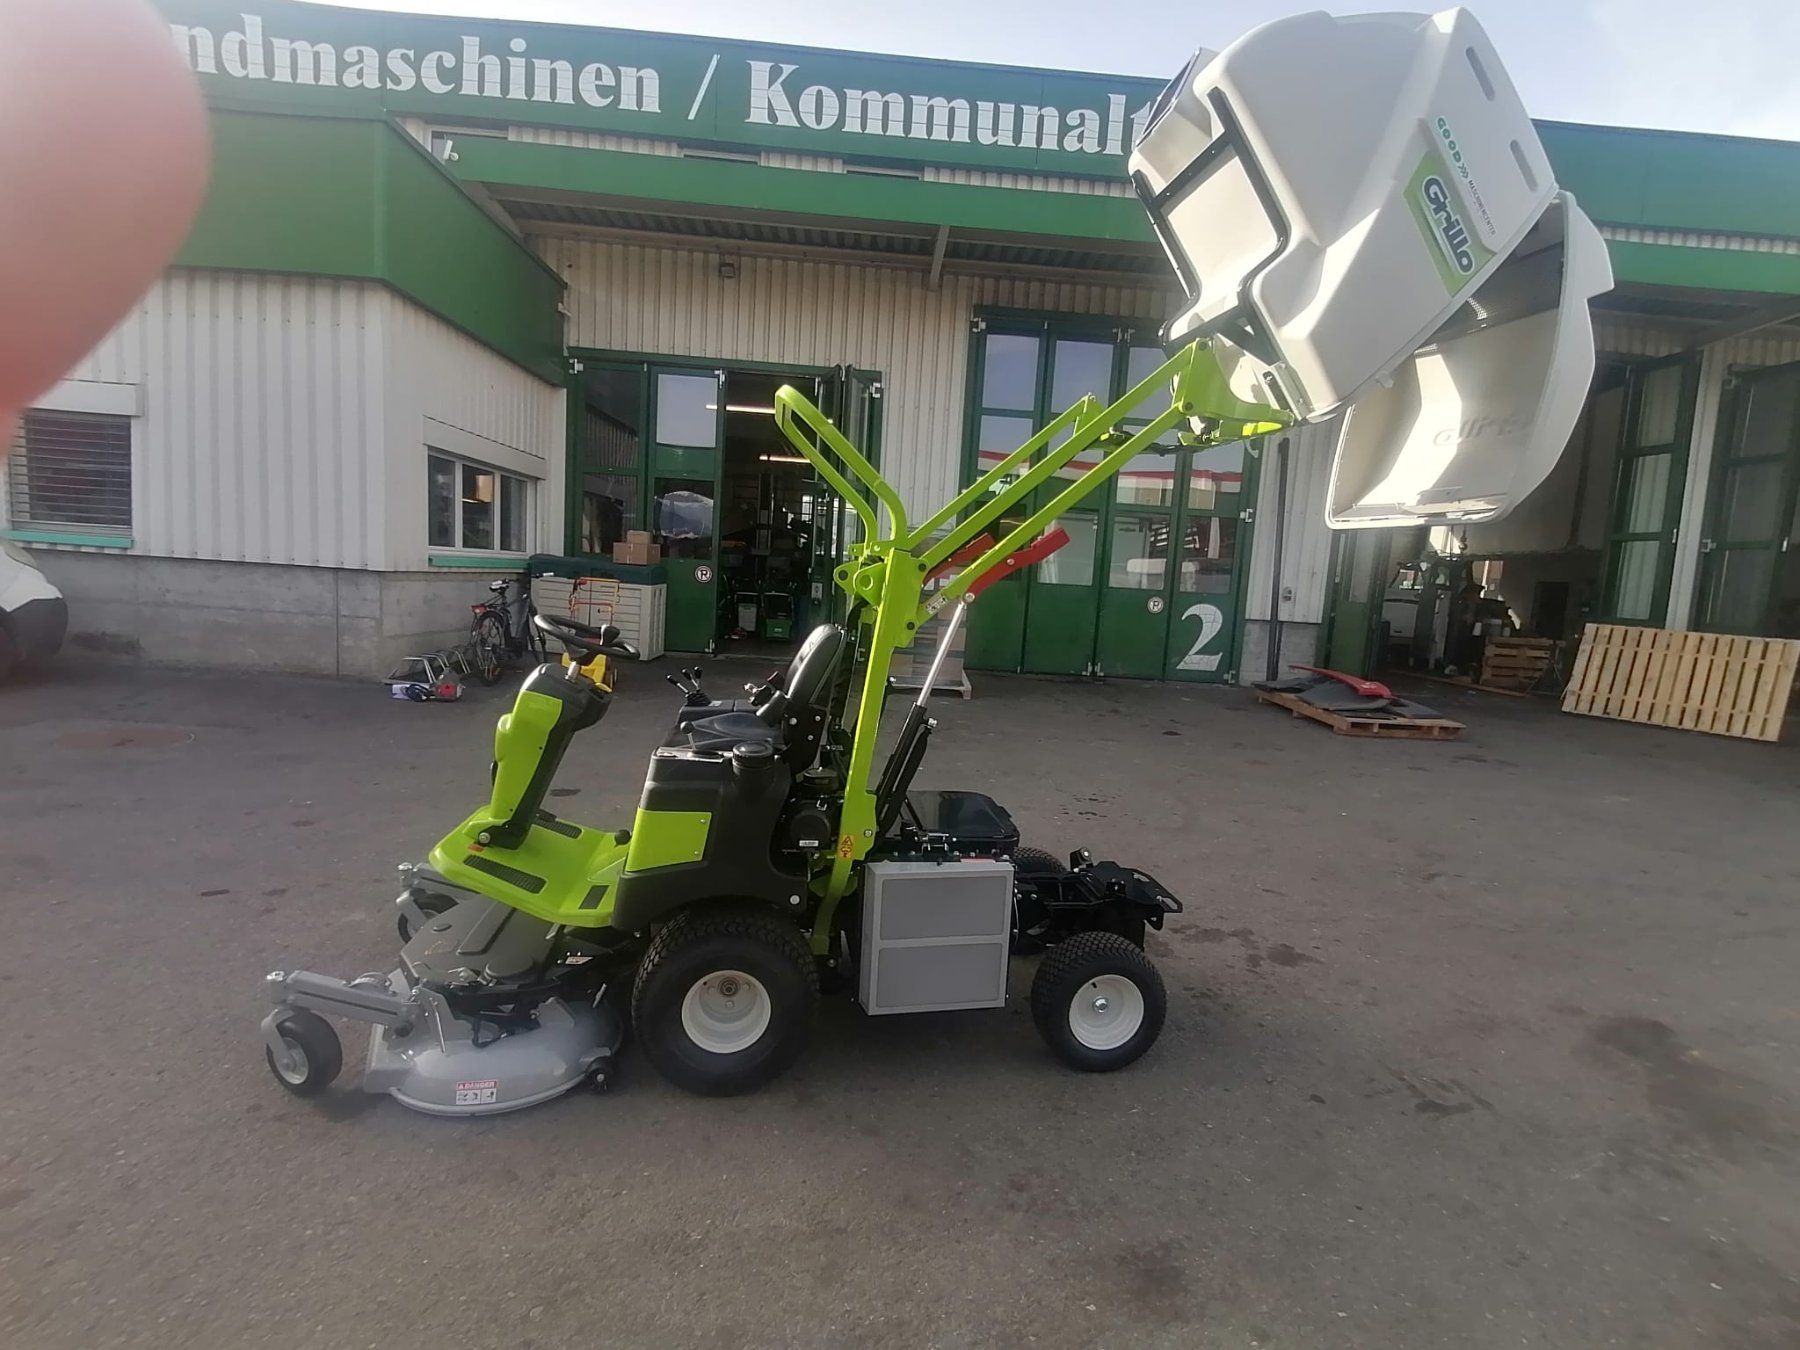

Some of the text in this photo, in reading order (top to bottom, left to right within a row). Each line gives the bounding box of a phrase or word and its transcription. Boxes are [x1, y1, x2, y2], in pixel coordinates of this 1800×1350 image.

[1437, 117, 1461, 163] GOOD
[1423, 177, 1473, 274] Grillo
[1176, 603, 1223, 671] 2
[464, 1081, 495, 1089] DANGER
